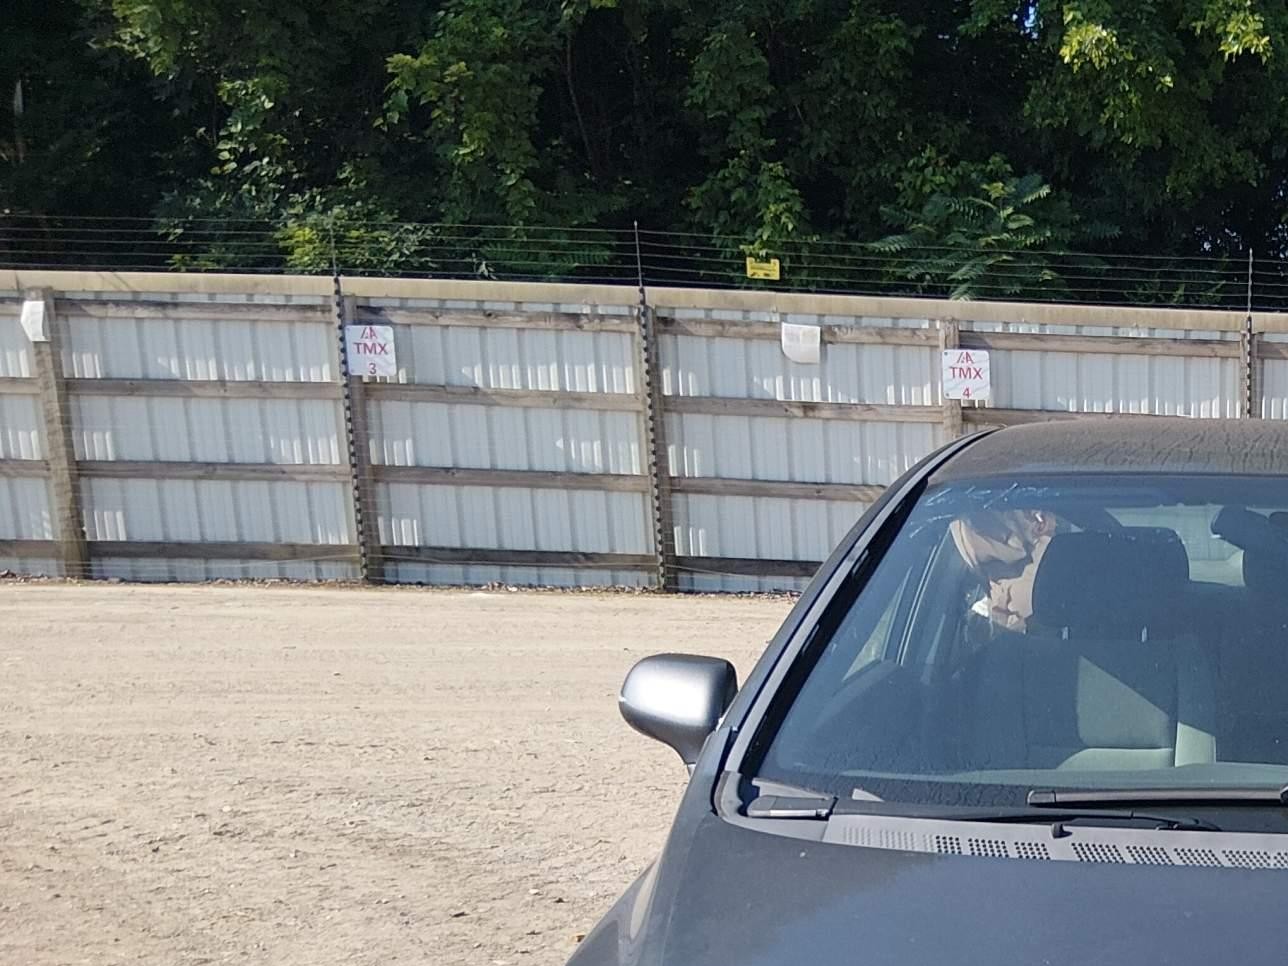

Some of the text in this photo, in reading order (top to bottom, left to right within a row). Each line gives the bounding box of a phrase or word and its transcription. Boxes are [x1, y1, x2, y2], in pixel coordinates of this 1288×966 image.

[353, 342, 389, 355] TMX
[369, 362, 377, 375] 3
[949, 366, 983, 380] TMX
[962, 386, 972, 399] 4
